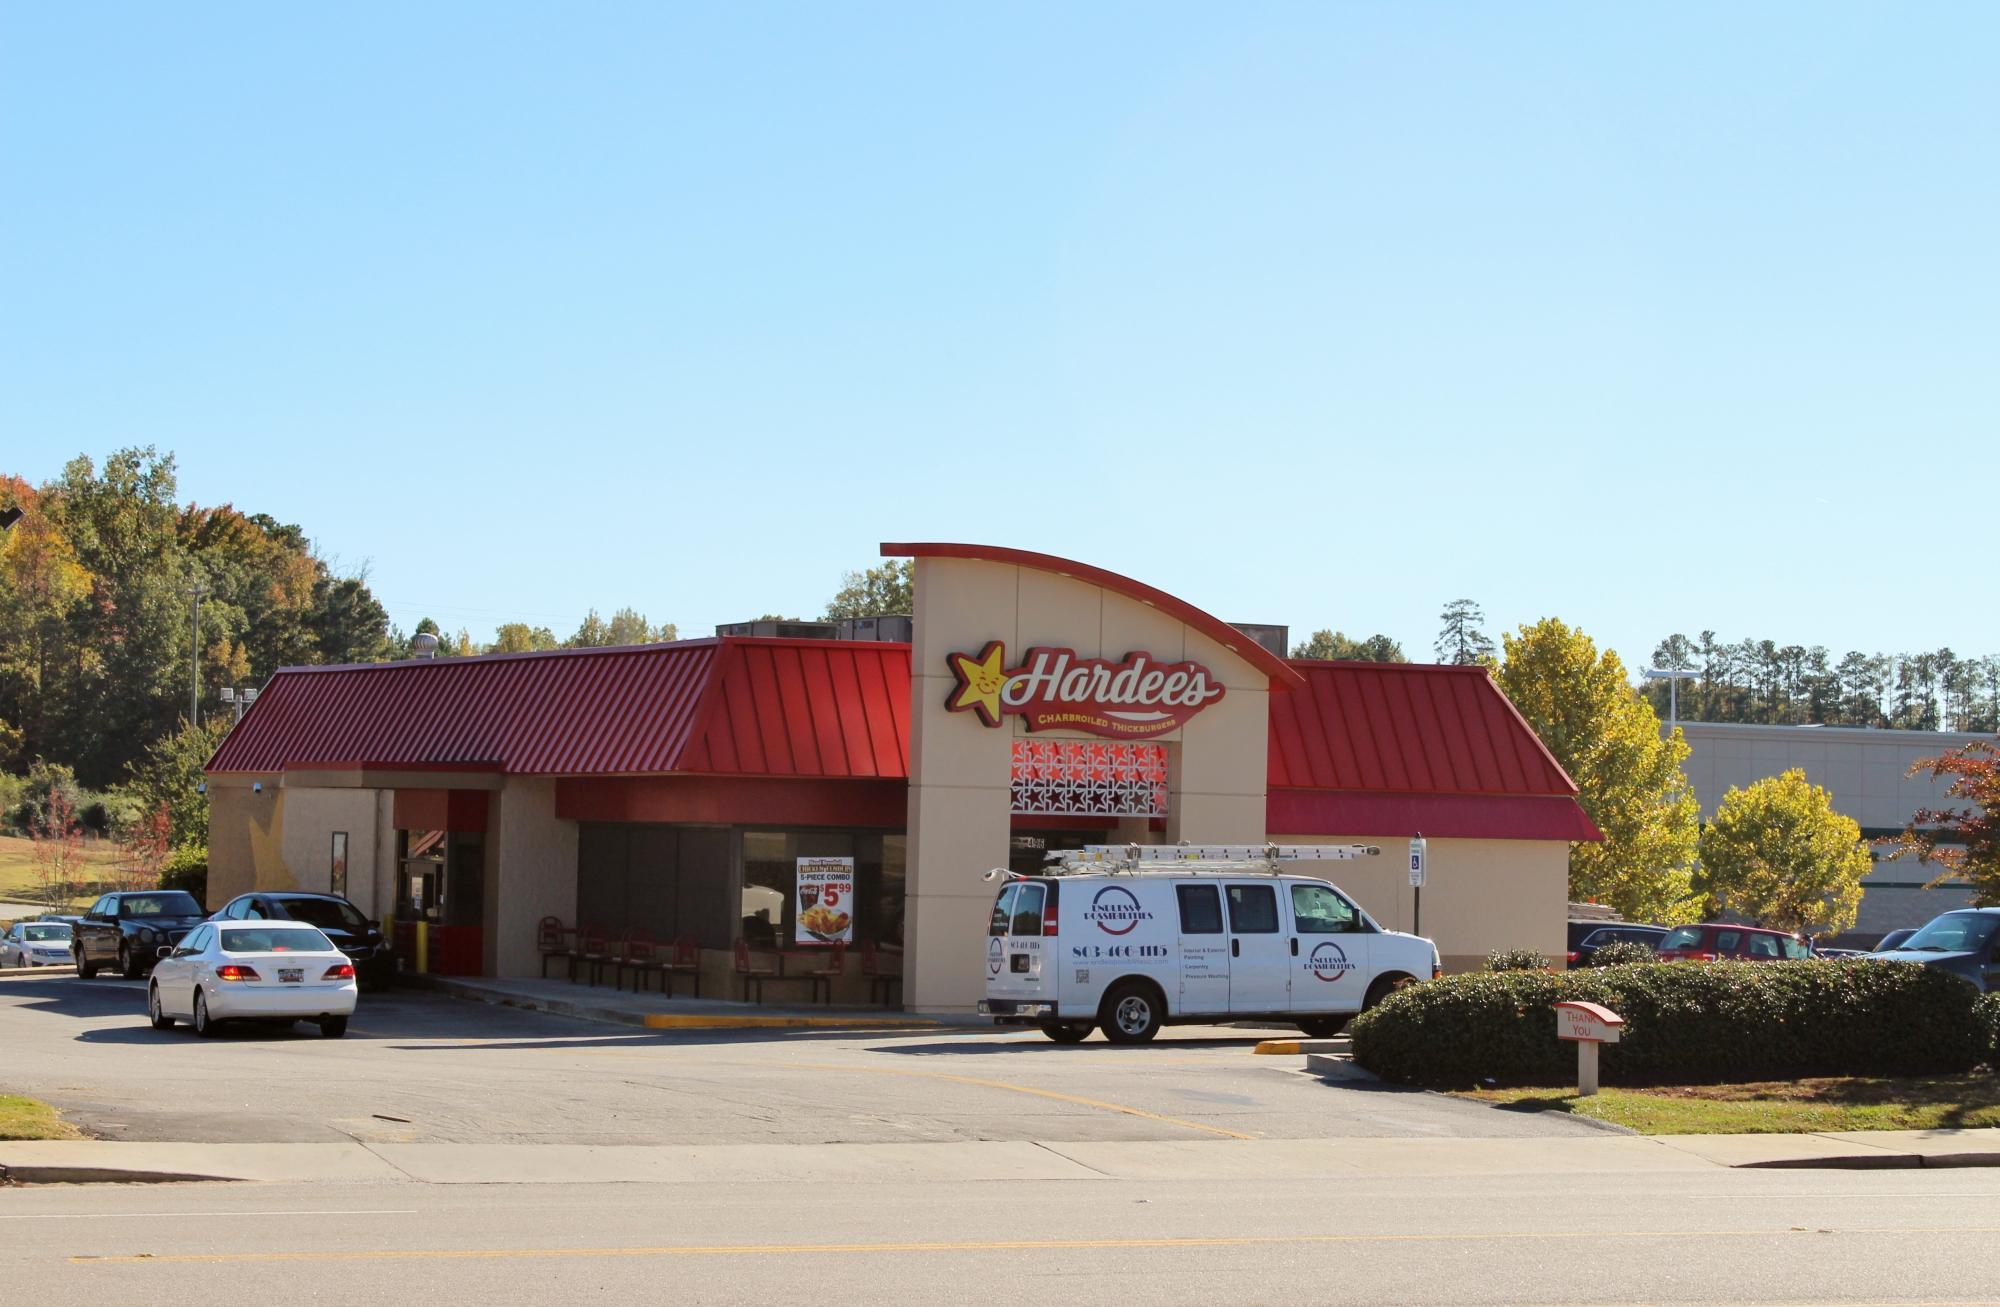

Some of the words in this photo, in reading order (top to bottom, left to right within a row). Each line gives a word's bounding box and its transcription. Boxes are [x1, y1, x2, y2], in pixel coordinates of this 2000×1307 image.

[1001, 653, 1219, 707] Hardee's
[1038, 713, 1108, 728] CHARBROILED
[826, 873, 851, 881] COMBO
[1092, 904, 1135, 912] ENDLESS
[1083, 912, 1153, 920] POSSIBILITIES
[1566, 1011, 1596, 1024] THANK
[1573, 1025, 1590, 1036] YOU
